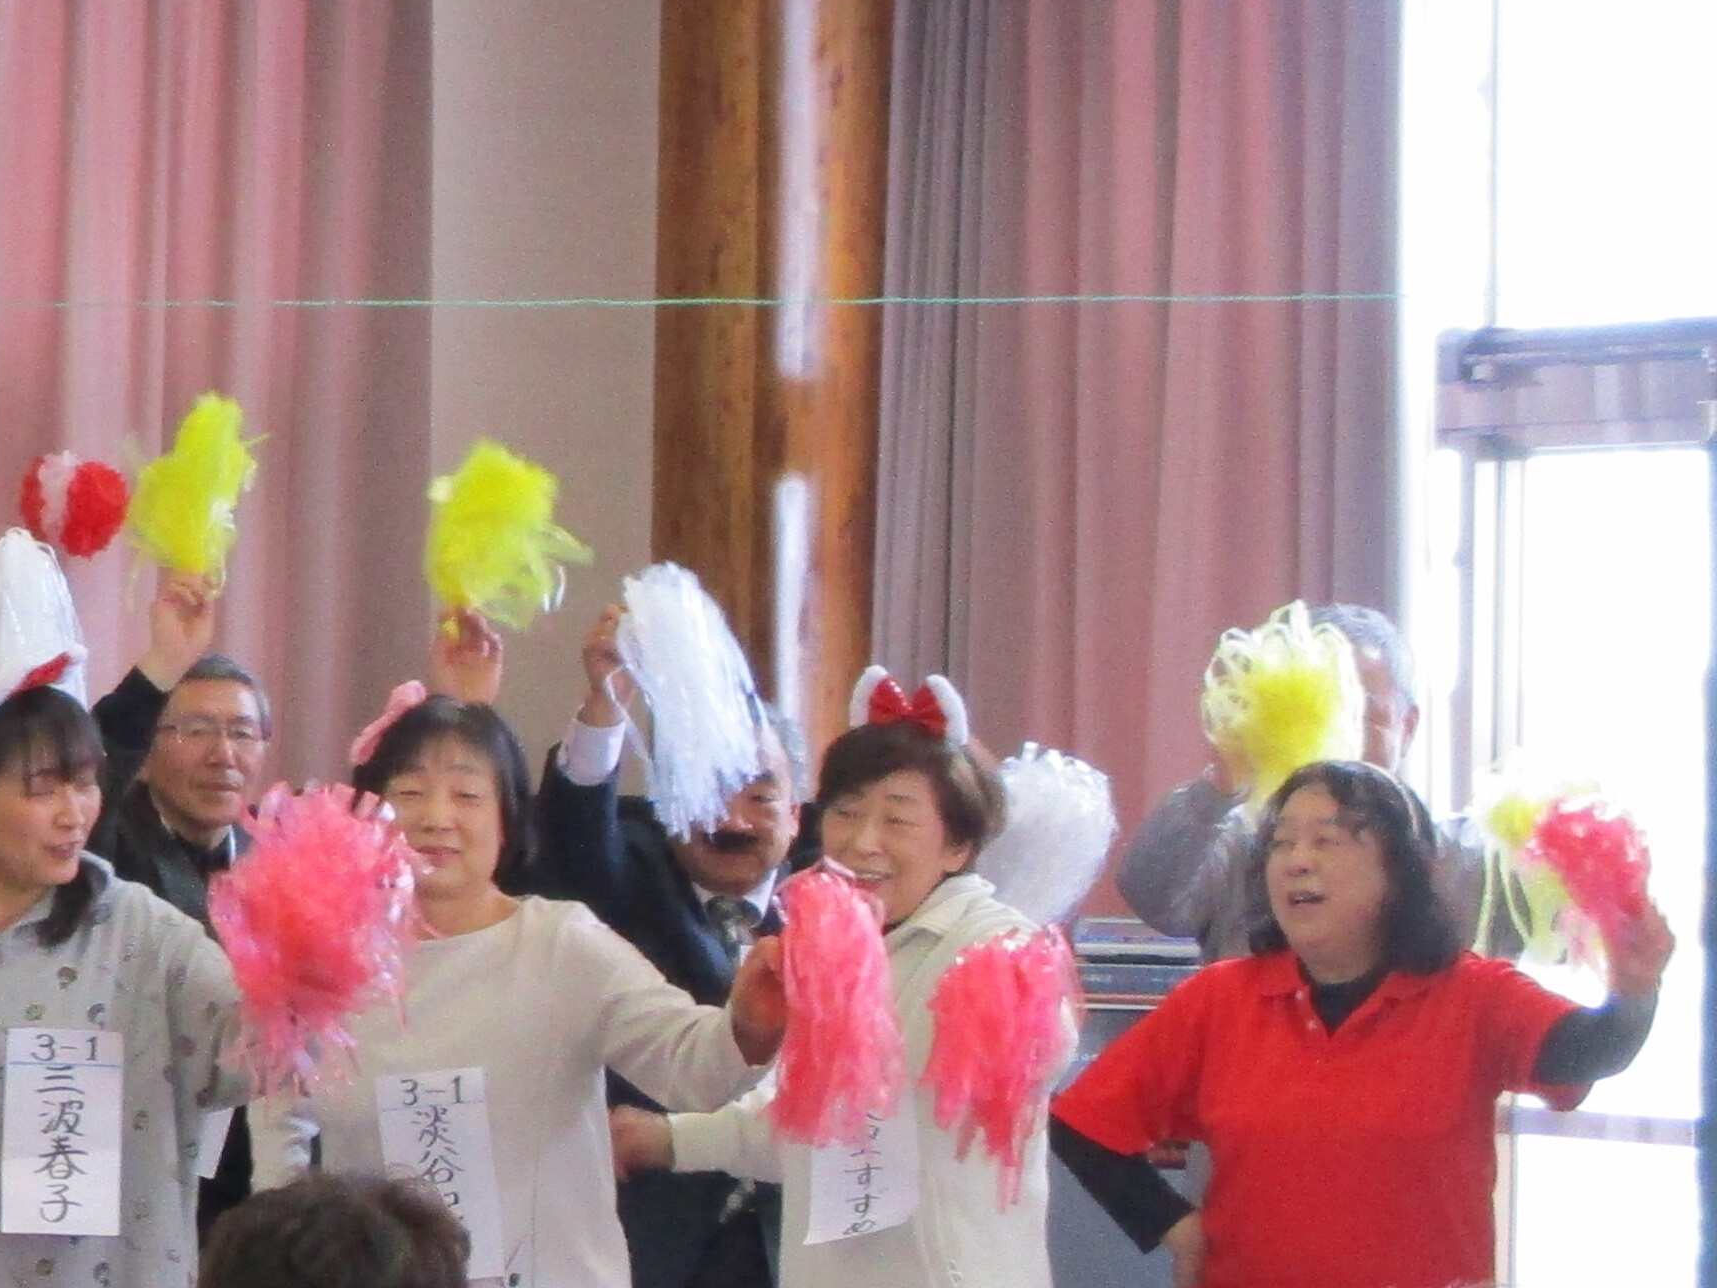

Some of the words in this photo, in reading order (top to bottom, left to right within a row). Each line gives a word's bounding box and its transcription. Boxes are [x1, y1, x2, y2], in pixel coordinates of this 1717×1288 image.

[29, 1033, 100, 1063] 3-1
[399, 1074, 465, 1106] 3-1
[34, 1065, 88, 1224] 三波春子
